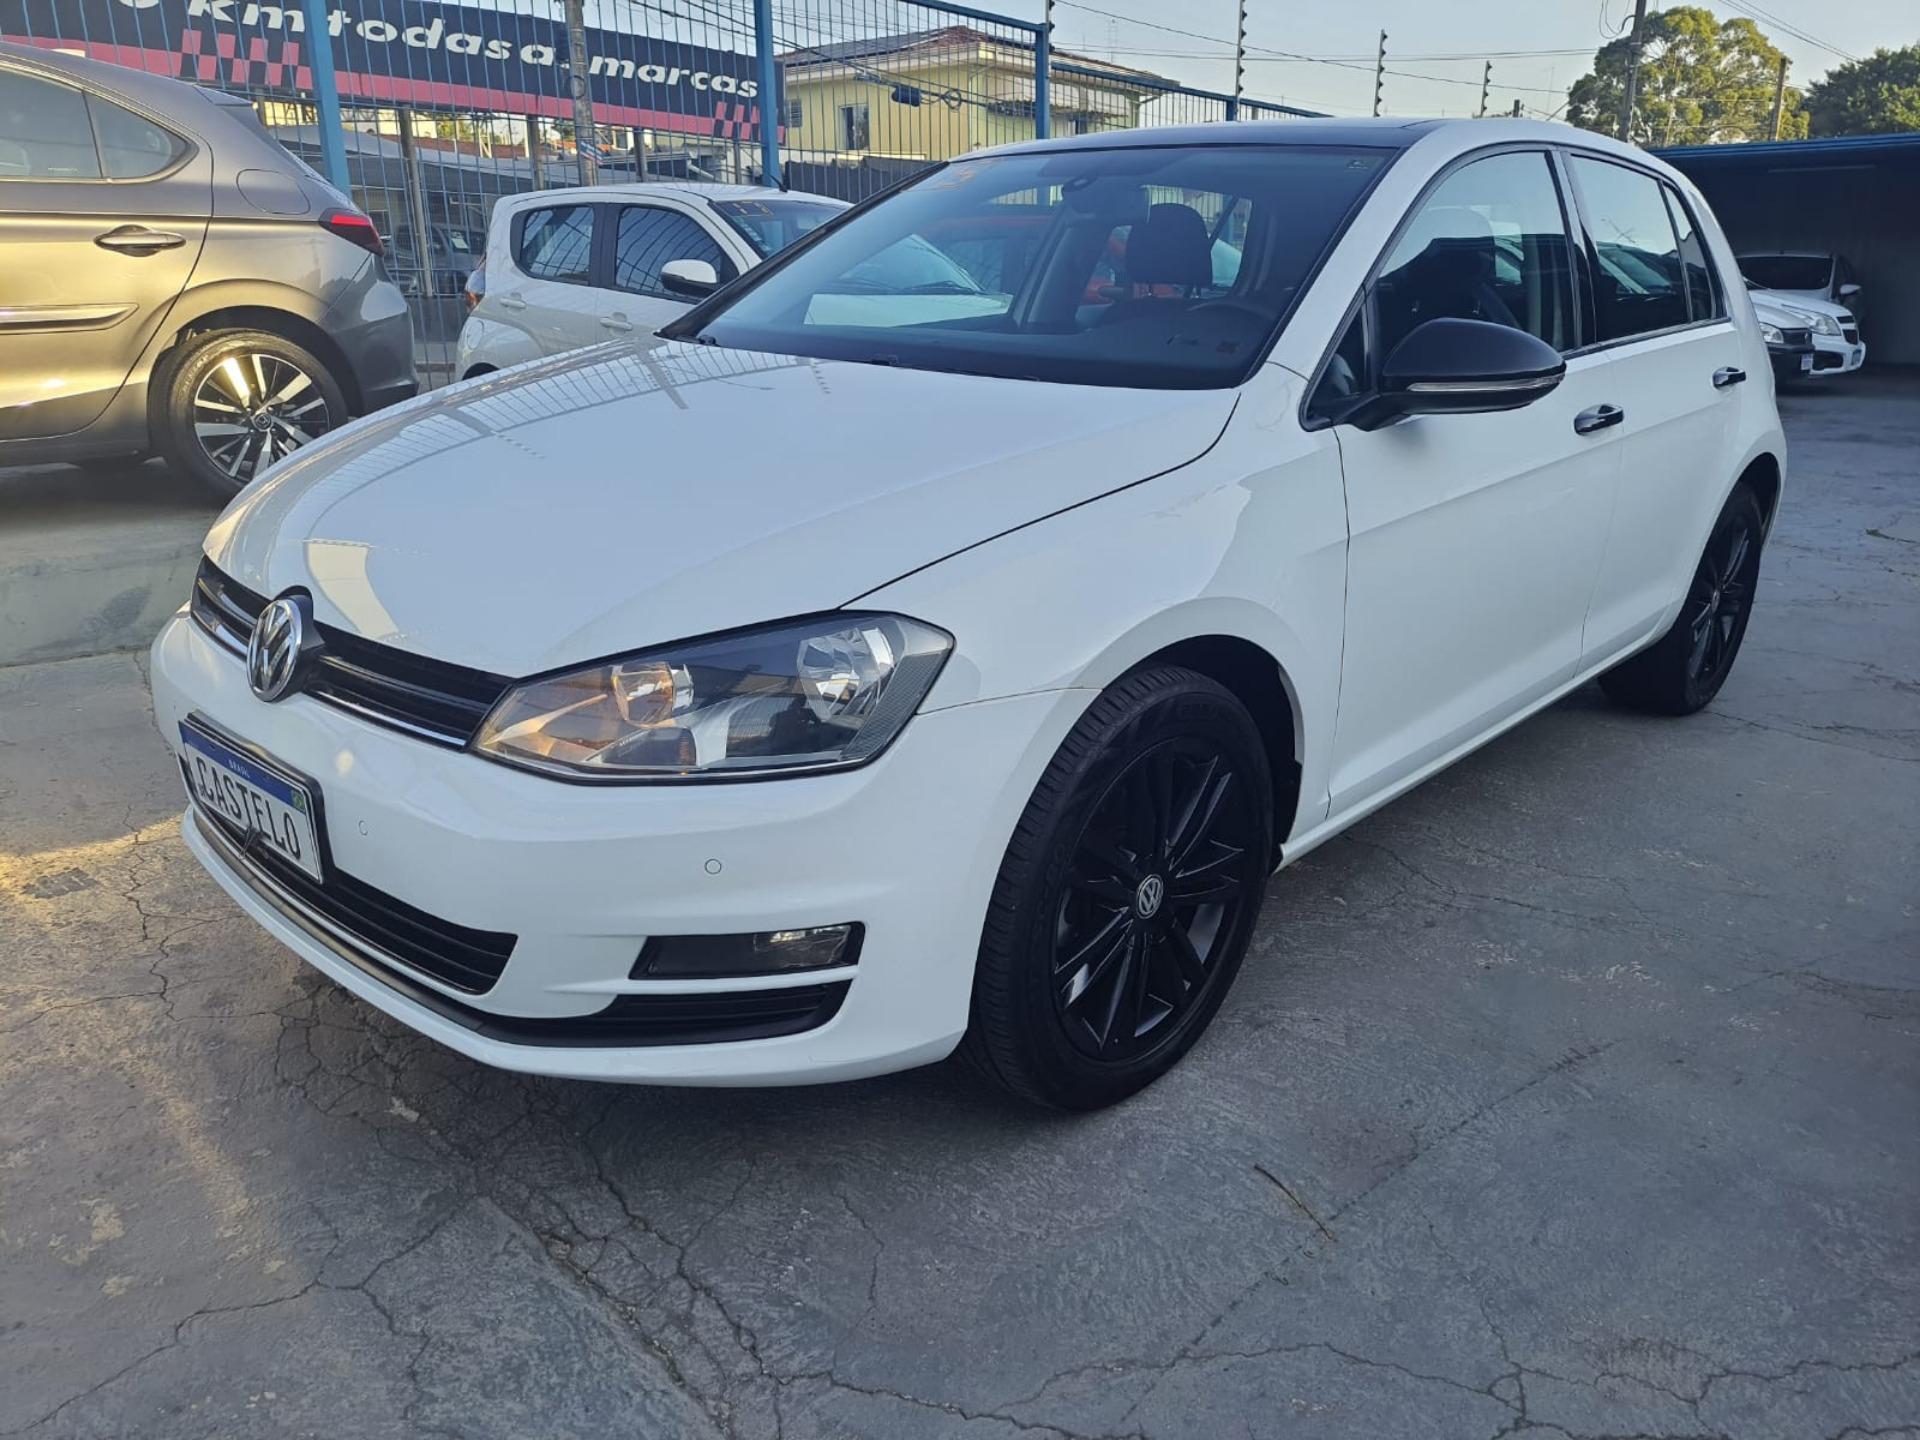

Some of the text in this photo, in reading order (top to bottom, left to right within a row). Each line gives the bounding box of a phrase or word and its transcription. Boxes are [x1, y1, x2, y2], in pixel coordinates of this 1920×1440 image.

[327, 9, 513, 60] todas
[520, 44, 570, 69] a
[589, 55, 758, 98] marcas
[196, 756, 301, 860] CASTELO
